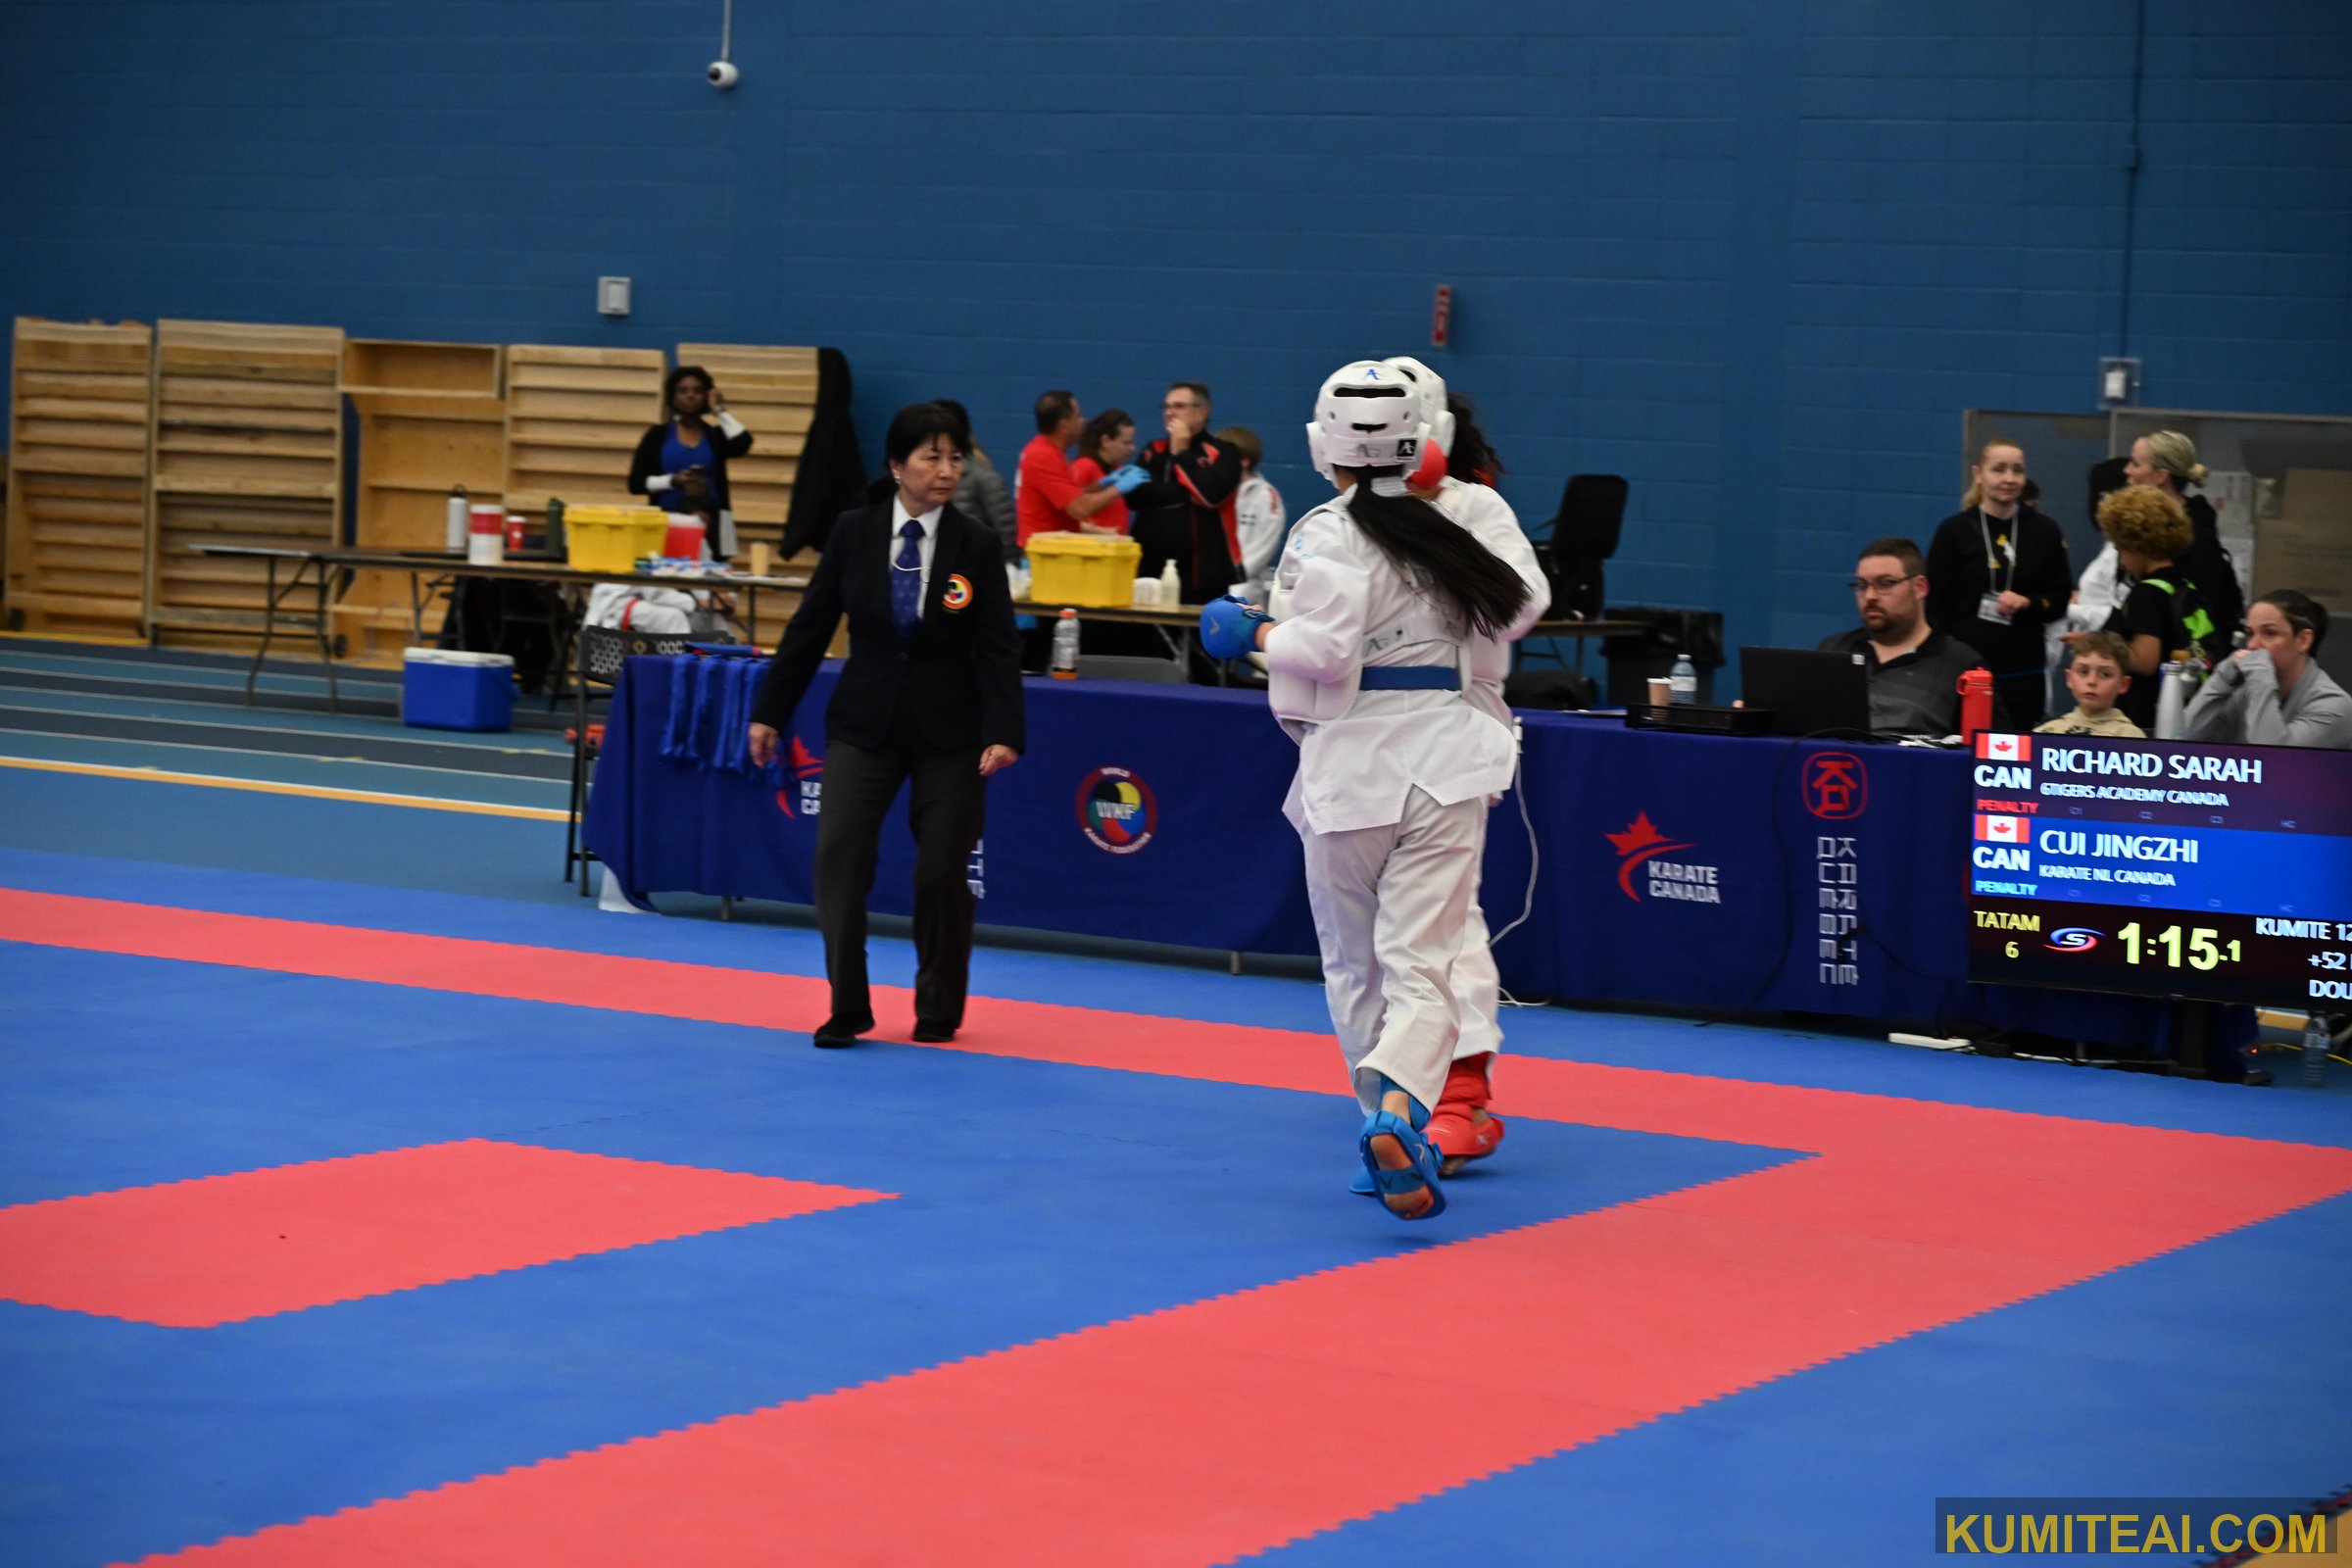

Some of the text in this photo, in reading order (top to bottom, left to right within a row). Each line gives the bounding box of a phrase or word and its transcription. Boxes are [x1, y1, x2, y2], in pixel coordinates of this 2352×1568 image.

[1974, 765, 2032, 790] CAN
[2041, 748, 2262, 784] RICHARD SARAH
[1977, 799, 2039, 813] PENALTY
[2096, 786, 2167, 803] ACADEMY
[2166, 790, 2230, 807] CANADA
[2039, 830, 2199, 863] CUI JINGZHI
[1973, 846, 2031, 871] CAN
[1647, 859, 1719, 885] KARATE
[2038, 864, 2092, 881] KARATE
[2114, 869, 2177, 887] CANADA
[1648, 879, 1722, 904] CANADA
[1975, 880, 2038, 896] PENALTY
[1973, 910, 2040, 932] TATAM
[2256, 917, 2331, 940] KUMITE
[2005, 941, 2020, 958] 6
[2308, 952, 2347, 970] +52
